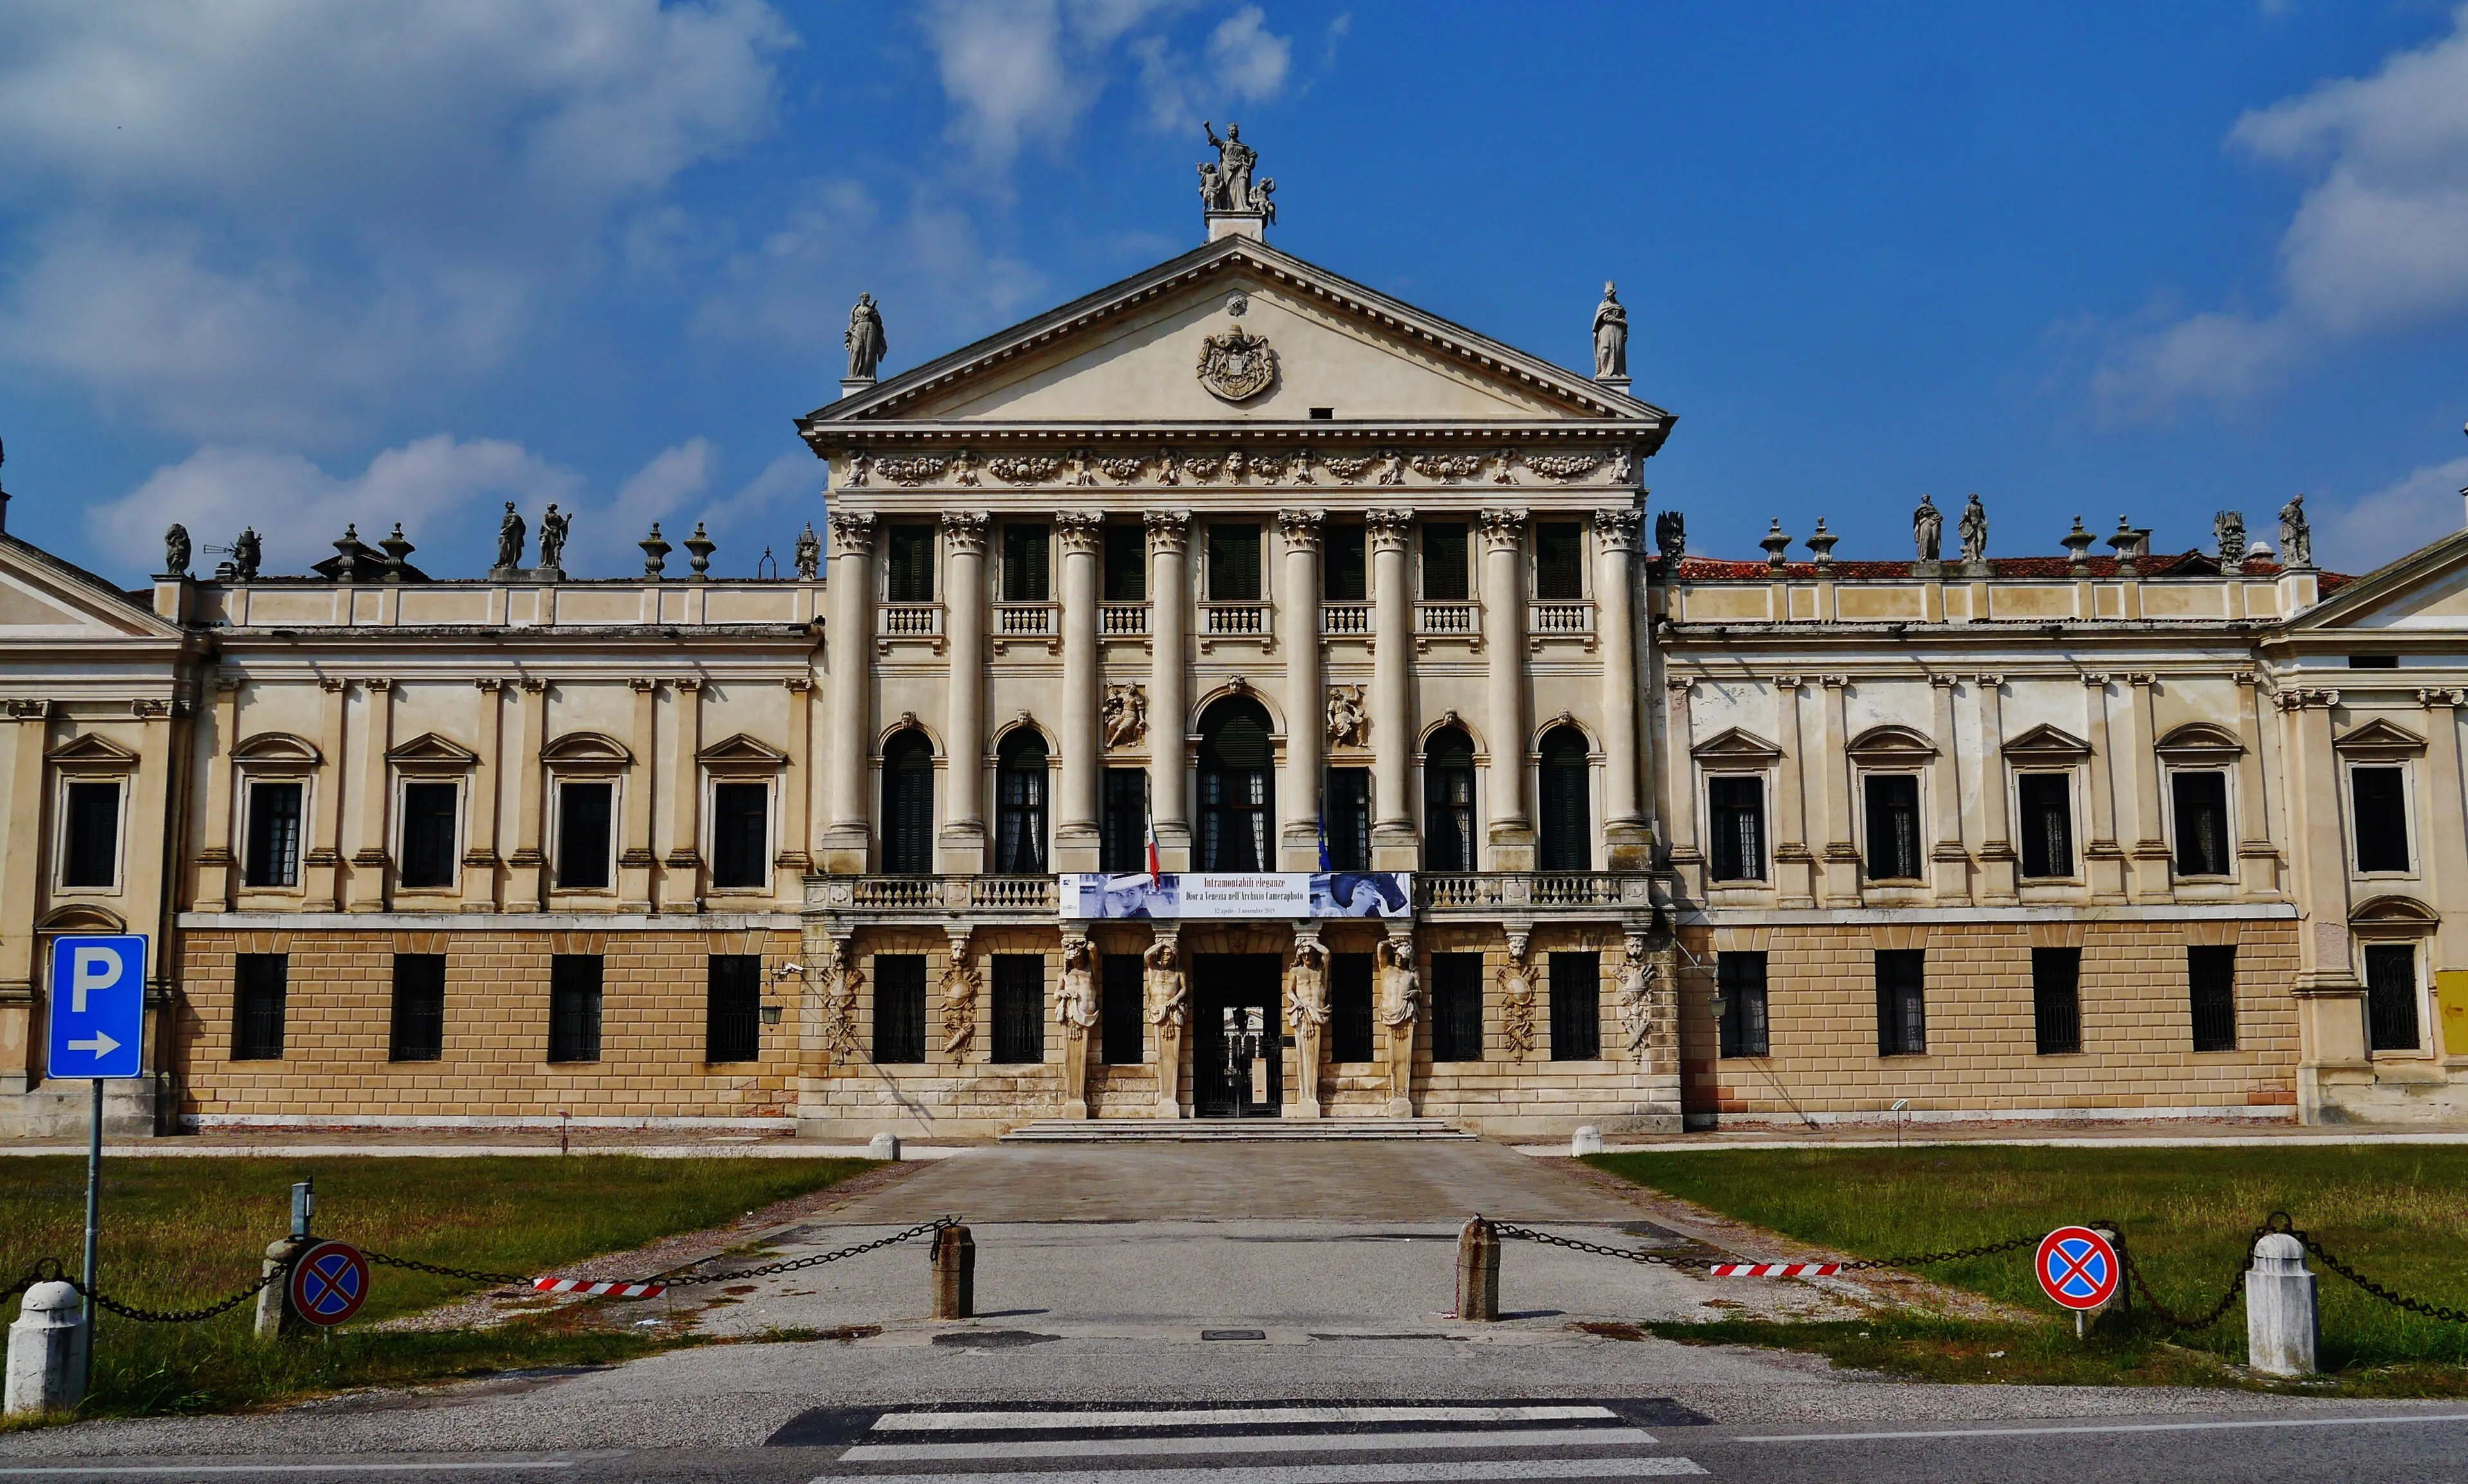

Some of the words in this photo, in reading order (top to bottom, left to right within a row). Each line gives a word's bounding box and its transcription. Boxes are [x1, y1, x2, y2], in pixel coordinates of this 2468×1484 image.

[1204, 877, 1254, 888] Intramontabili
[1256, 877, 1285, 890] eleganze
[1186, 891, 1199, 900] Dior
[1205, 891, 1227, 900] Venezia
[1265, 891, 1303, 902] Cameraphoto
[72, 947, 123, 1012] P
